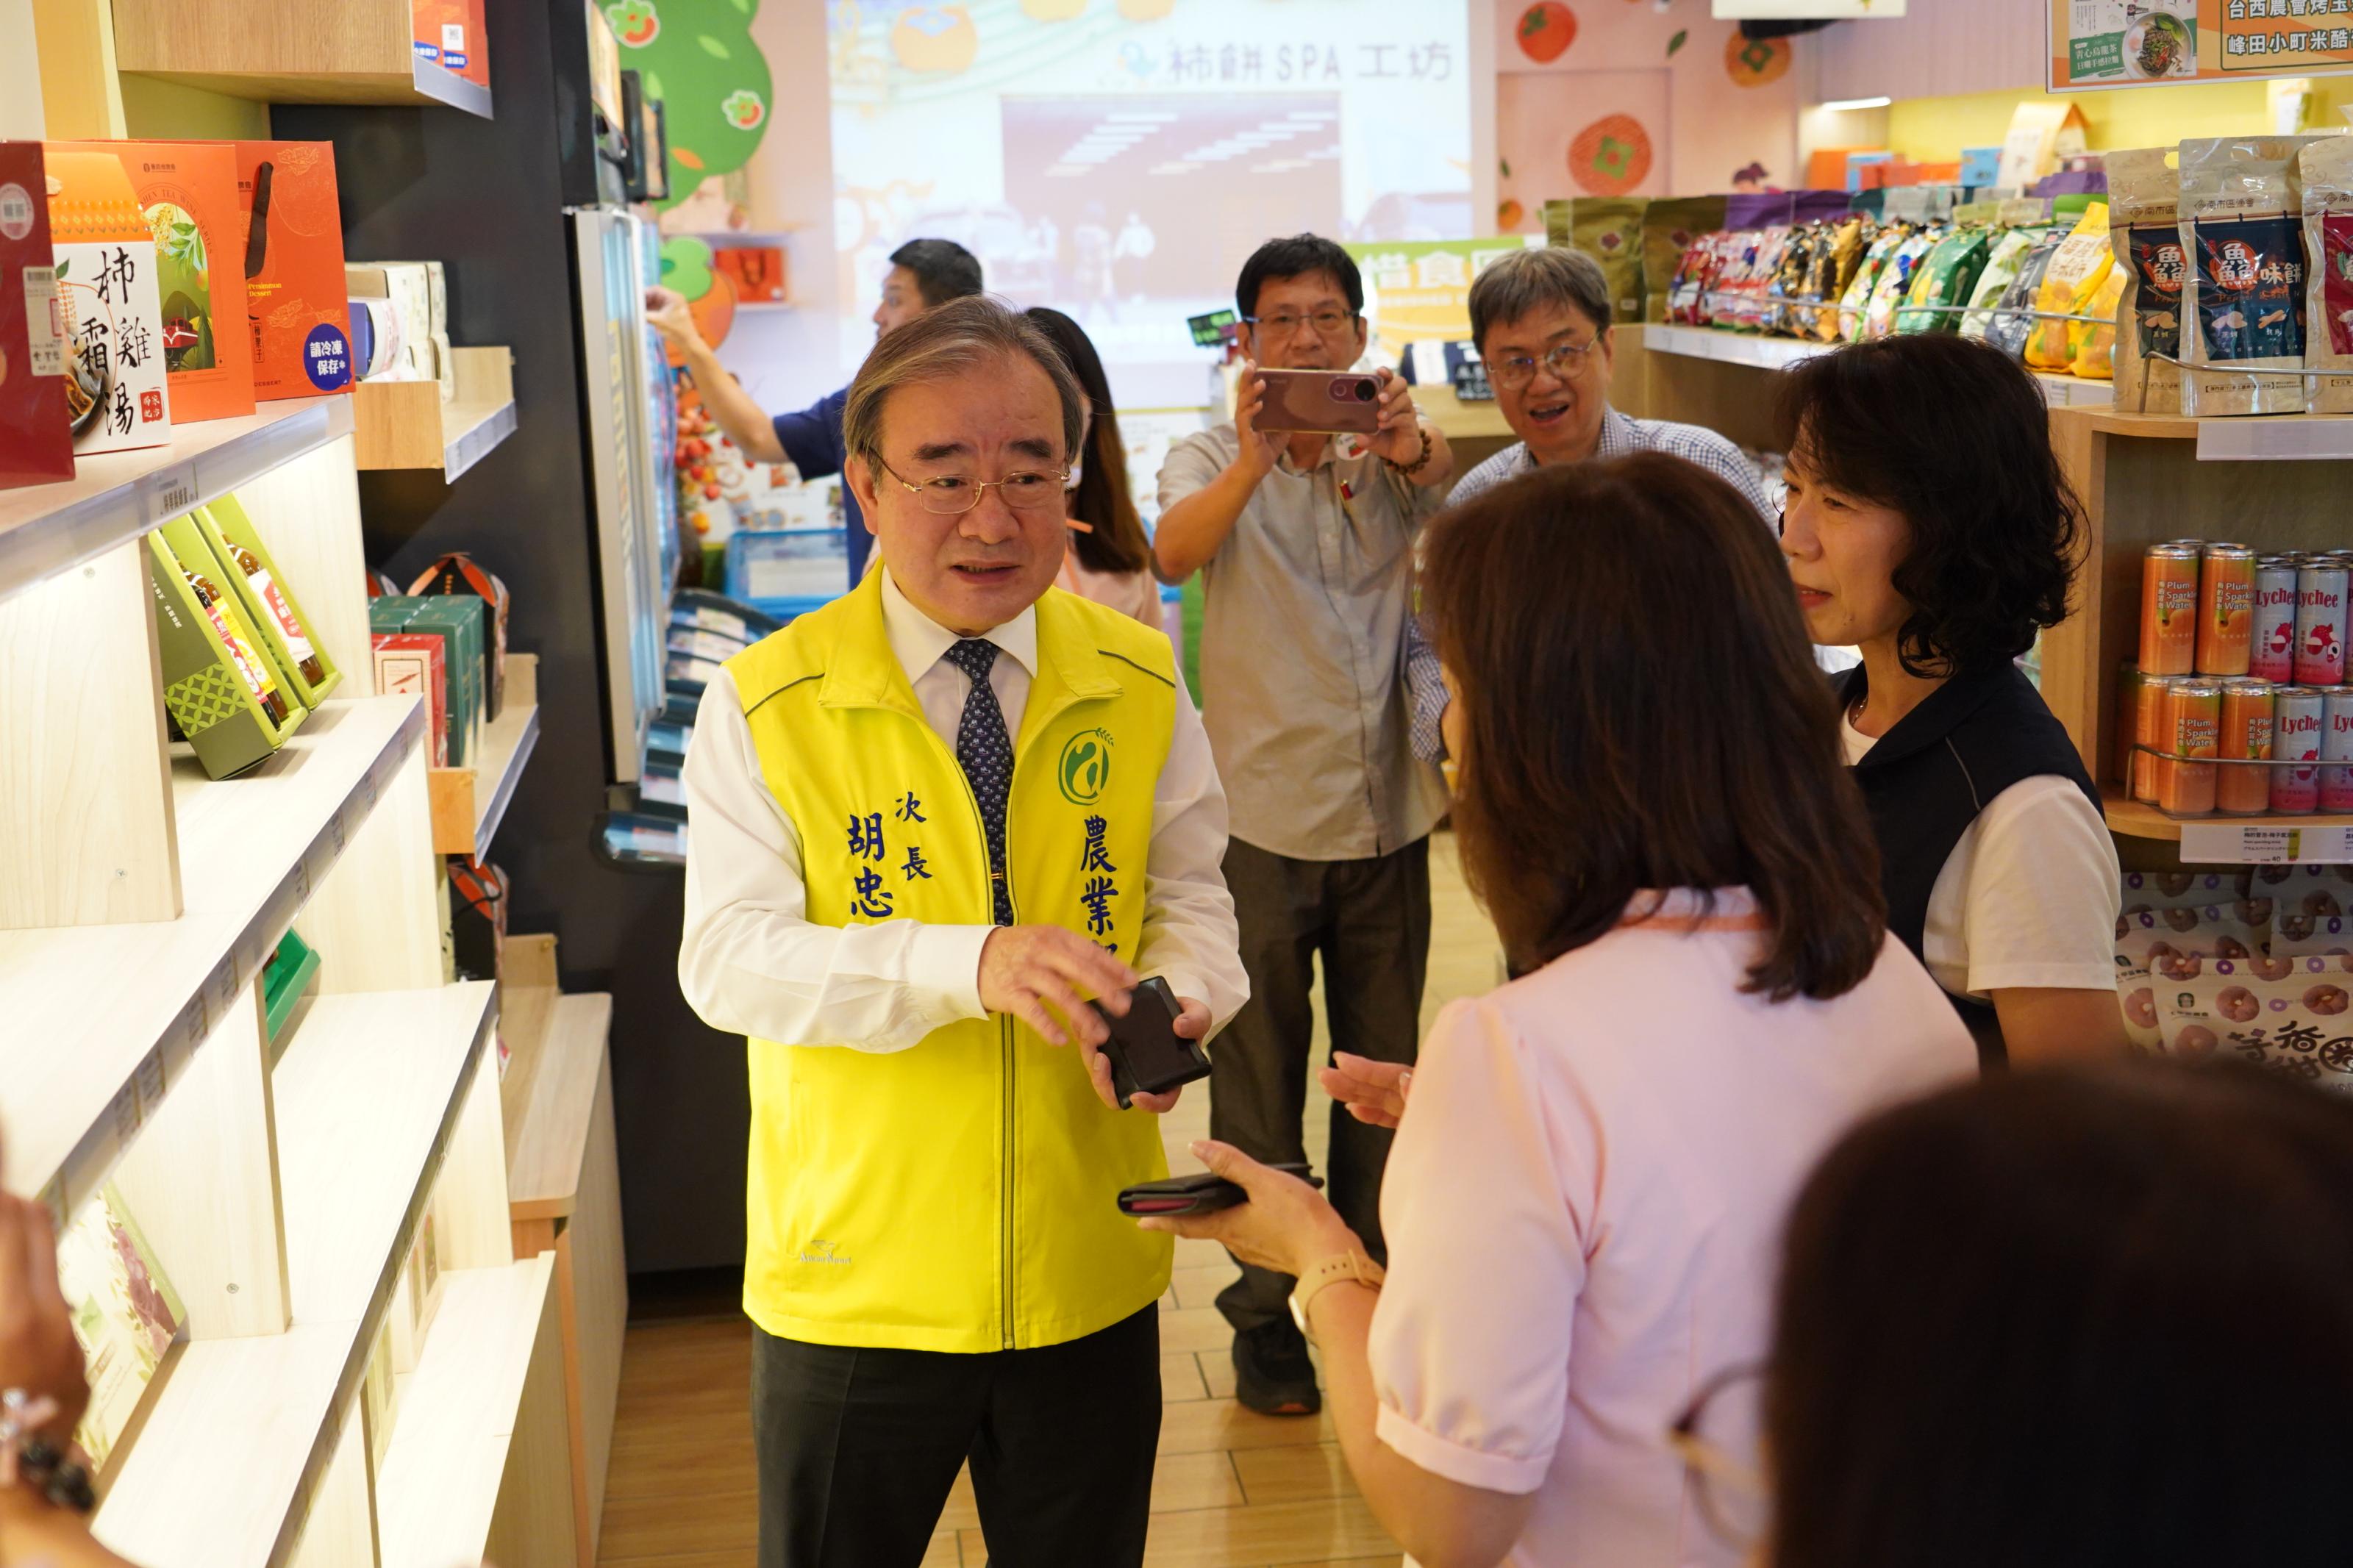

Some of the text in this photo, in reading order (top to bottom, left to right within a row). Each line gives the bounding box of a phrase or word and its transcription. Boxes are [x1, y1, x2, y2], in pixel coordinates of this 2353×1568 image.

[2229, 0, 2353, 19] 台西農會烤玉
[2228, 29, 2353, 54] 峰田小町米酷
[1275, 43, 1343, 82] SPA
[1357, 40, 1453, 82] 工坊
[2340, 192, 2353, 202] 南
[309, 340, 343, 359] 請冷凍
[317, 359, 340, 376] 保存
[2187, 719, 2211, 727] Plum
